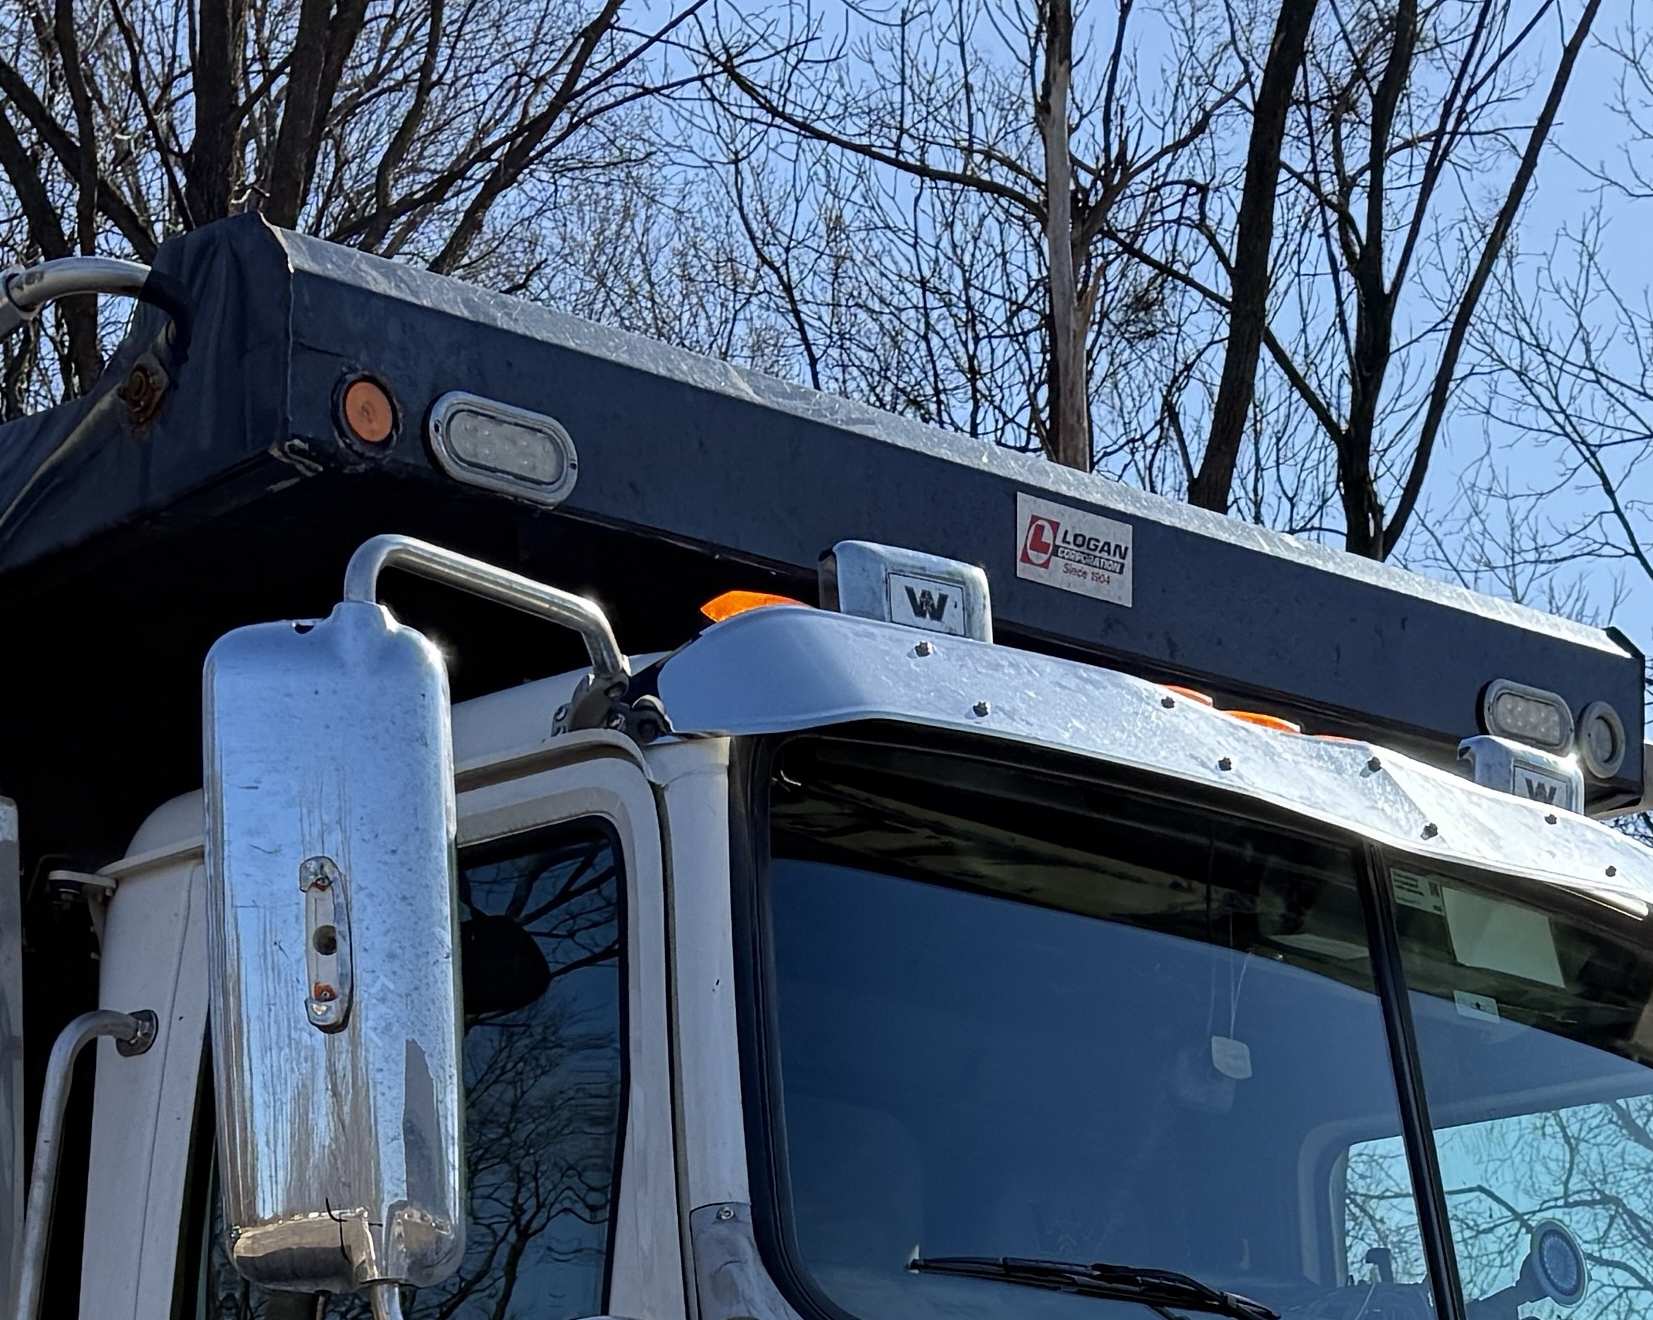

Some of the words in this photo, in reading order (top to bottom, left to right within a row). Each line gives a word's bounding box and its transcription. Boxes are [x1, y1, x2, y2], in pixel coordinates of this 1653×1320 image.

[1062, 529, 1129, 560] LOGAN
[1057, 547, 1122, 574] CORPORATION
[1062, 562, 1088, 580] Since
[904, 585, 949, 622] W
